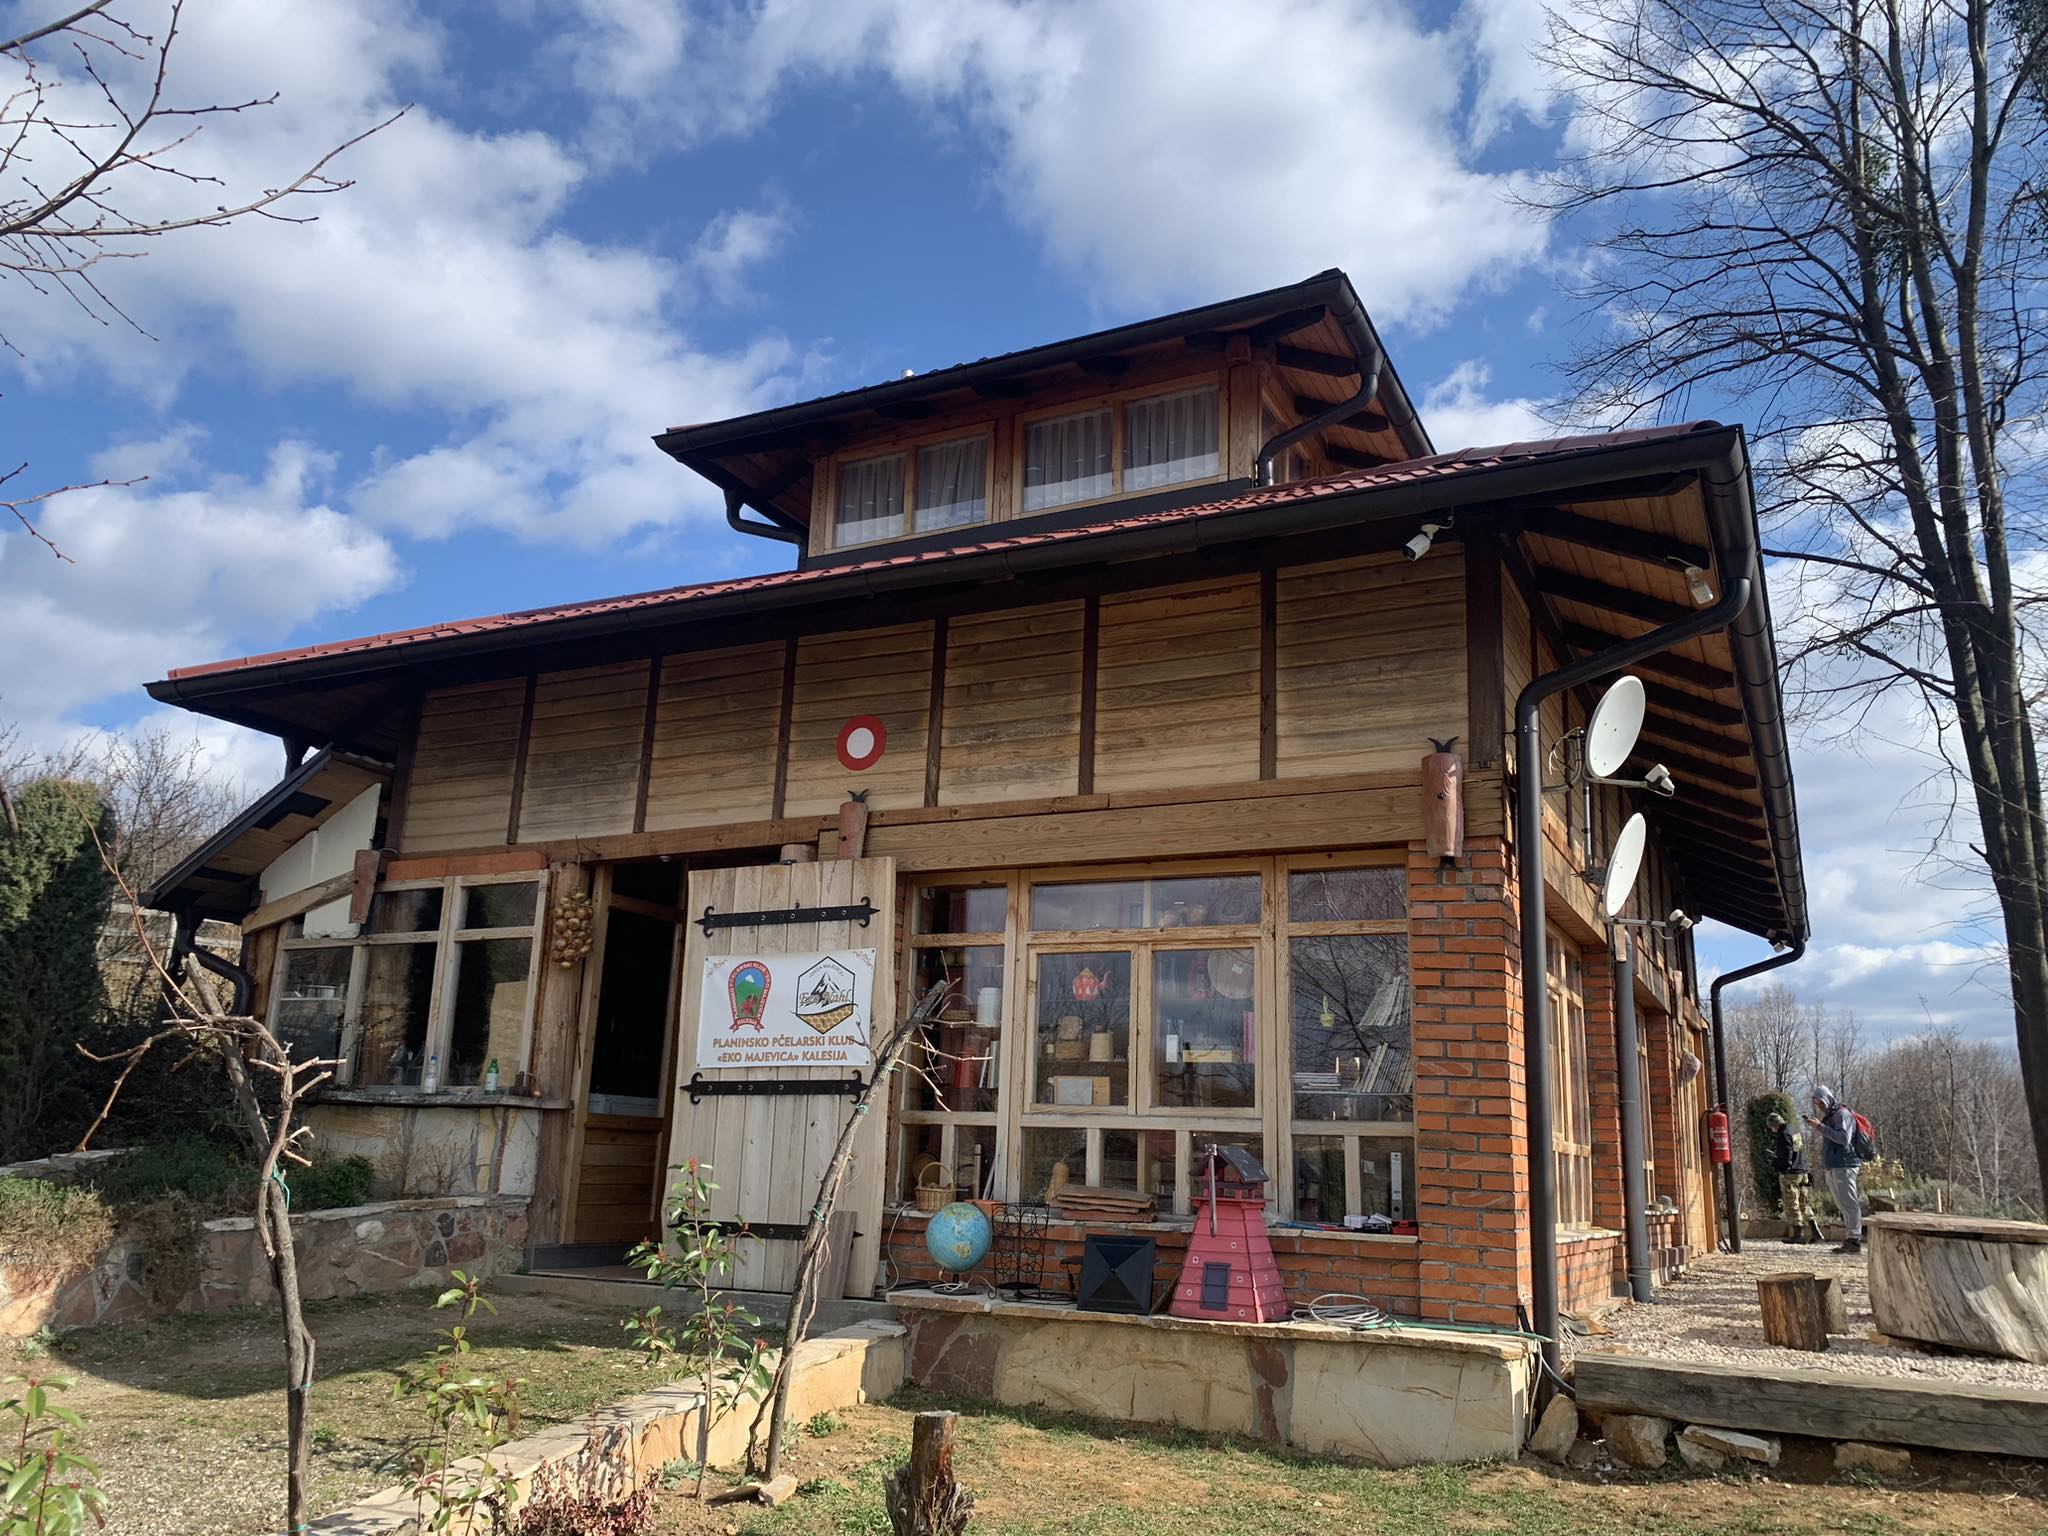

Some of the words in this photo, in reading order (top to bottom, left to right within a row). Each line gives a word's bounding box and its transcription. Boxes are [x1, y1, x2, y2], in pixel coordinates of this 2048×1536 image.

[713, 1038, 769, 1048] PLANINSKO
[772, 1034, 826, 1047] PČELARSKI
[828, 1035, 855, 1046] KLUB
[801, 1051, 848, 1061] KALESIJA
